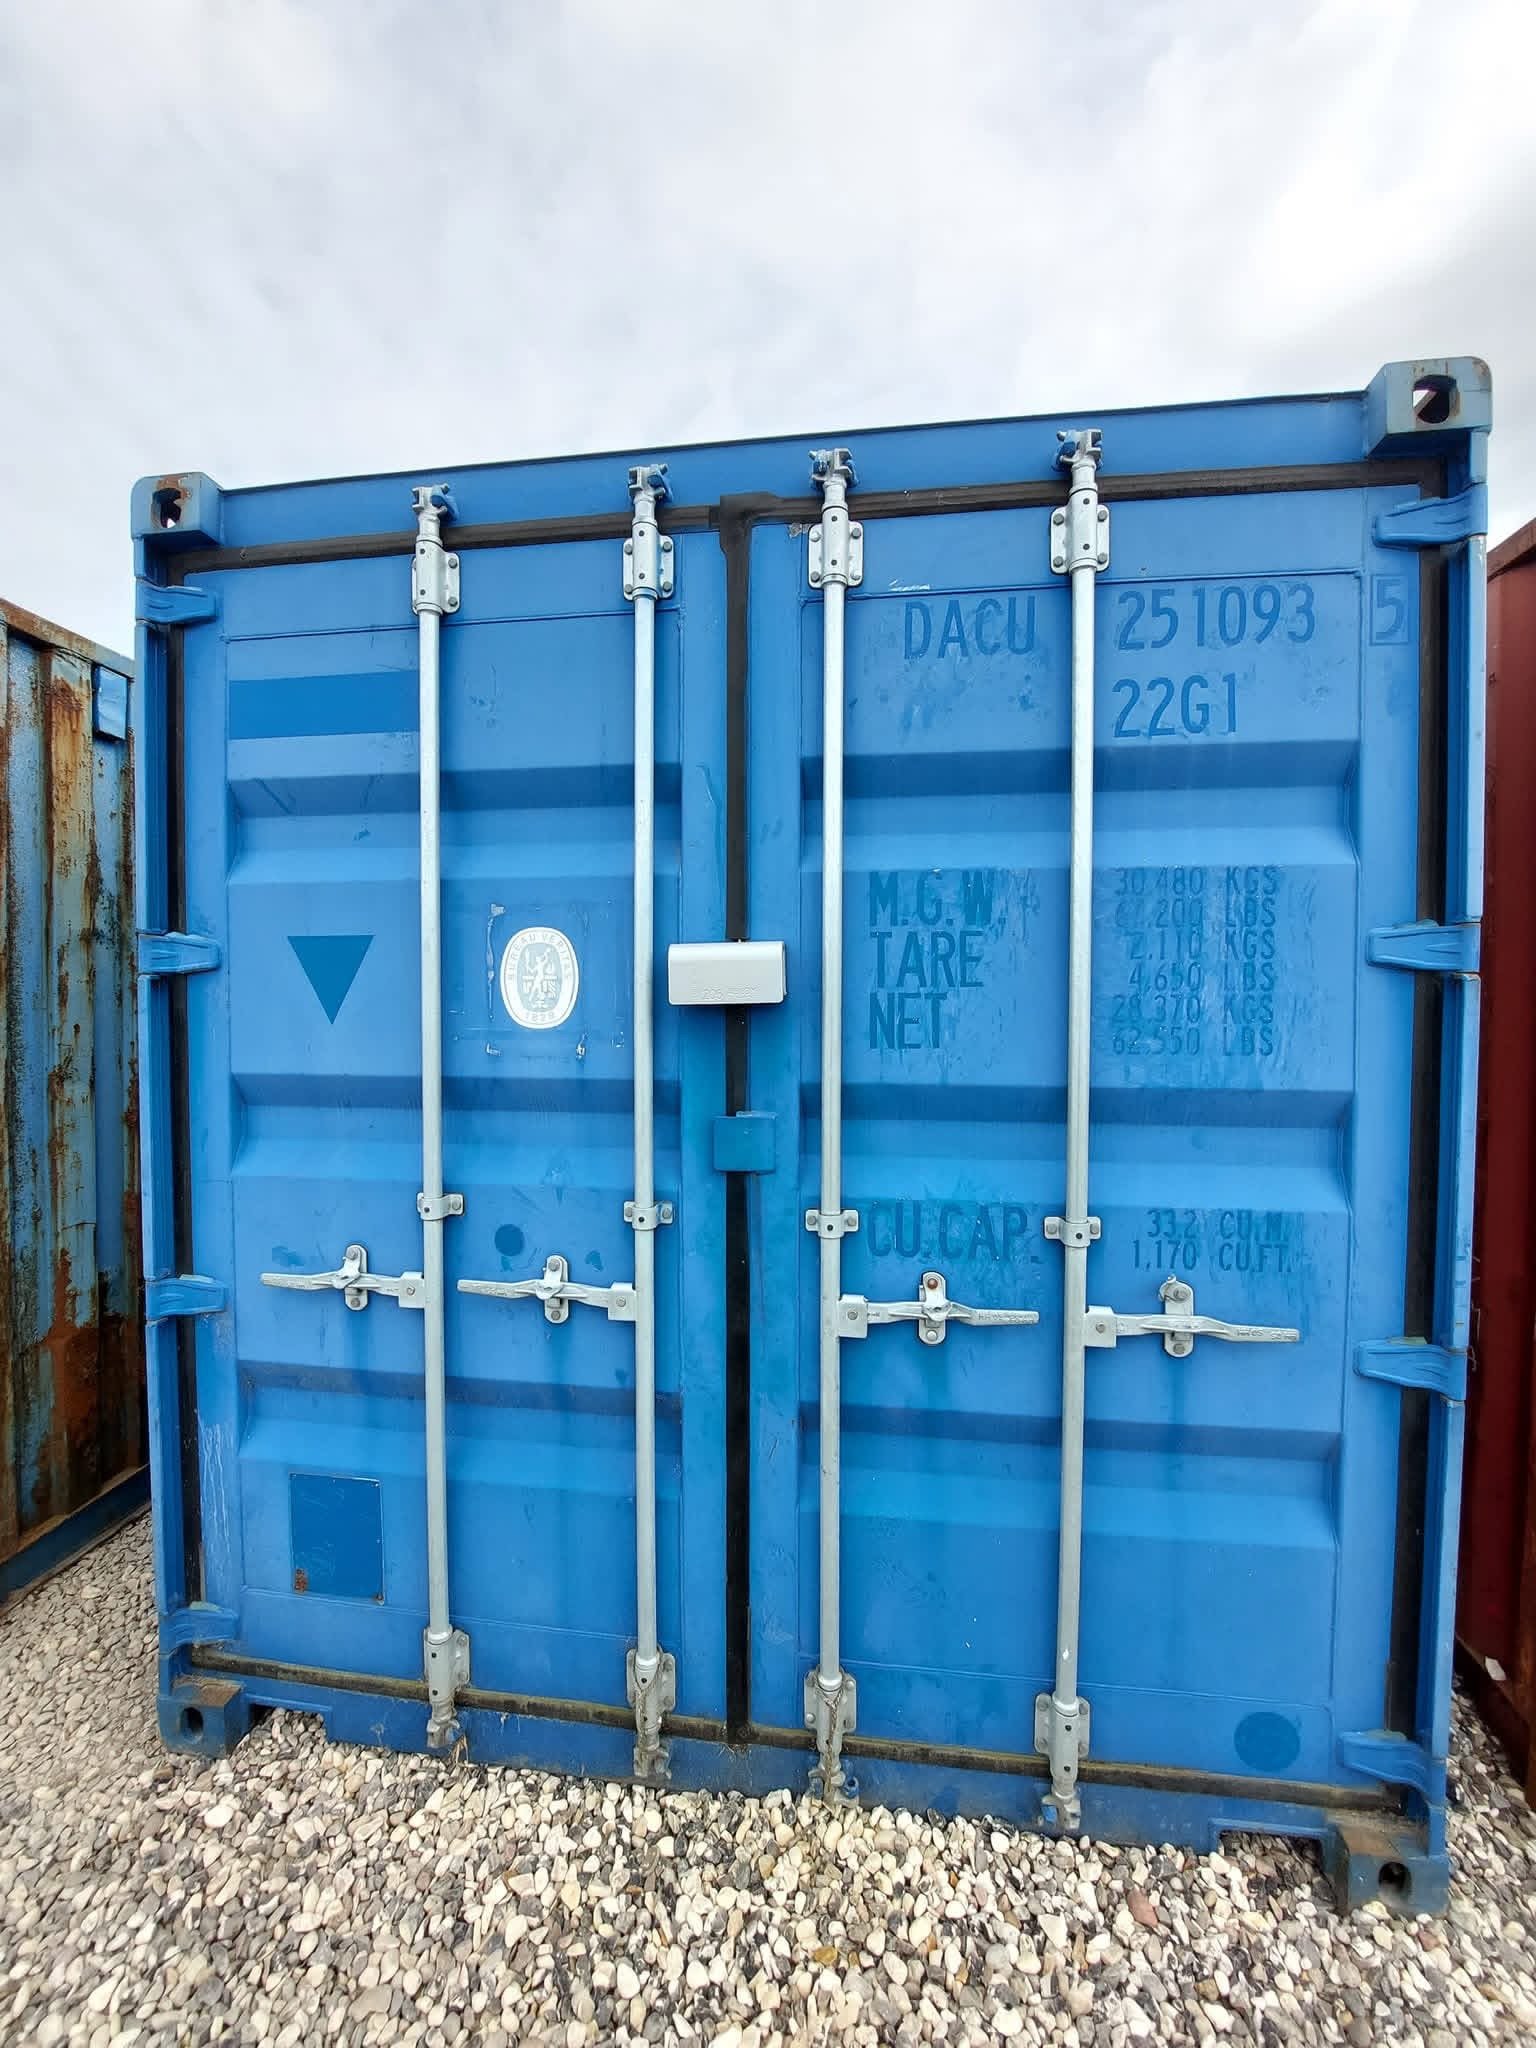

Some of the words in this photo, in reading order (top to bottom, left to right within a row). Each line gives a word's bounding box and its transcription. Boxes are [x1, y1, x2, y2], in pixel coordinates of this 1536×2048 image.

[903, 596, 1037, 660] DACU
[1116, 584, 1316, 652] 251093
[1376, 579, 1405, 641] 5
[1111, 672, 1239, 738] 22G1
[1112, 866, 1204, 896] 30480
[1225, 866, 1278, 896] KGS
[1223, 897, 1277, 928] LBS
[869, 930, 985, 988] TARE
[1224, 929, 1276, 960] KGS
[1222, 962, 1275, 992] LBS
[868, 991, 949, 1049] NET
[1222, 993, 1274, 1025] KGS
[1223, 1026, 1274, 1057] LBS
[1145, 1208, 1197, 1238] 33.2
